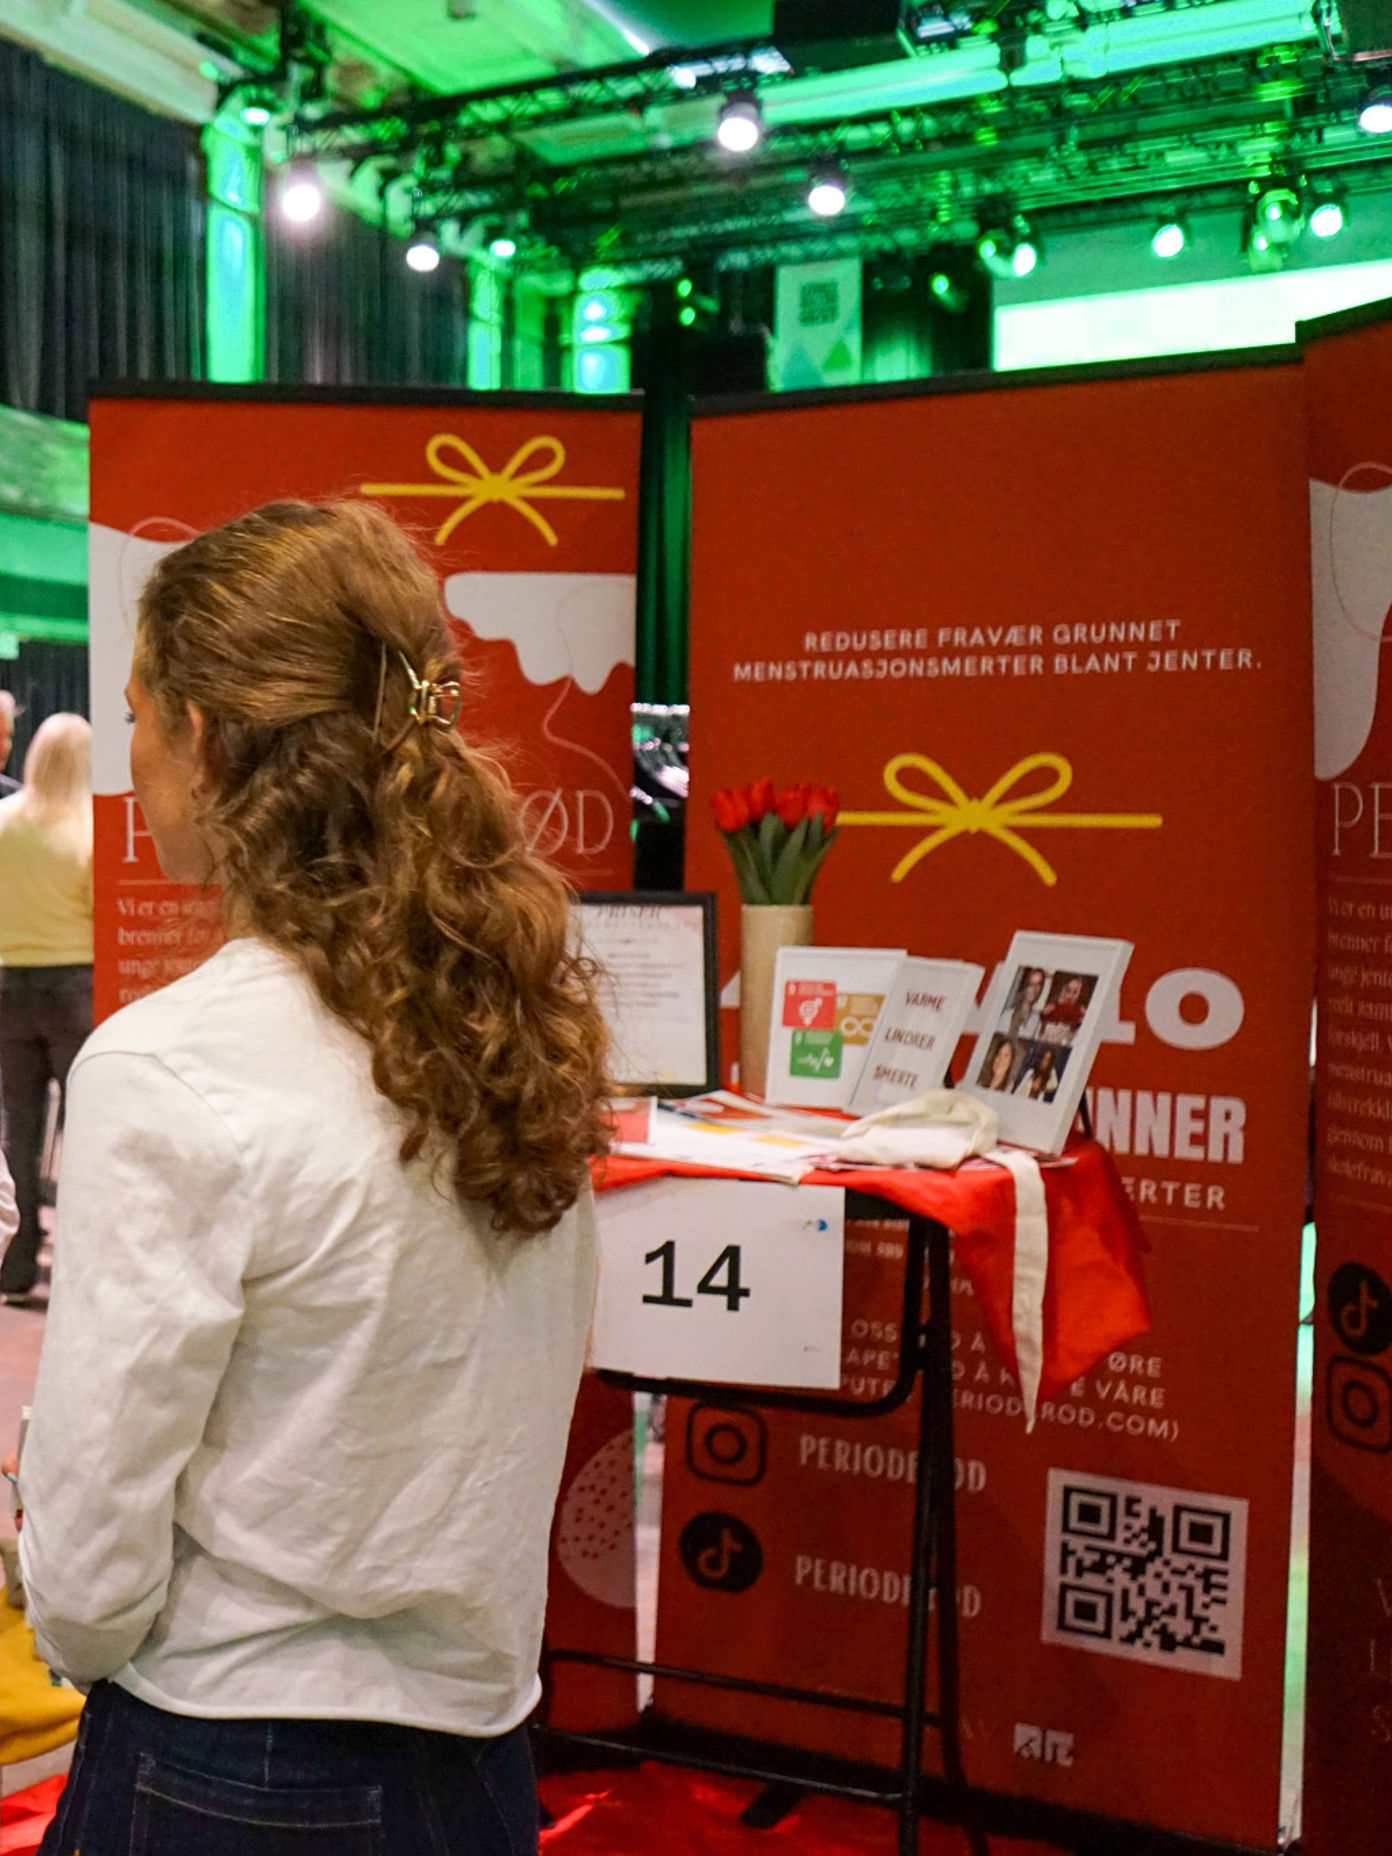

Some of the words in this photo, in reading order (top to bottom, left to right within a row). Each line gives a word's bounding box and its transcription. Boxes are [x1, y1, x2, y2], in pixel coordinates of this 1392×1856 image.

[804, 628, 928, 652] REDUSERE
[938, 624, 1043, 648] FRAVÆR
[1053, 619, 1181, 645] GRUNNET
[733, 653, 1044, 682] MENSTRUASJONSMERTER
[1054, 651, 1138, 675] BLANT
[1146, 648, 1261, 672] JENTER.
[906, 991, 946, 1012] VARME
[884, 1027, 936, 1051] LINDRER
[873, 1065, 920, 1089] SMERTE
[1086, 1086, 1247, 1165] NNER
[639, 1239, 751, 1312] 14
[799, 1433, 987, 1492] PERIODED
[794, 1554, 982, 1618] PERIODD
